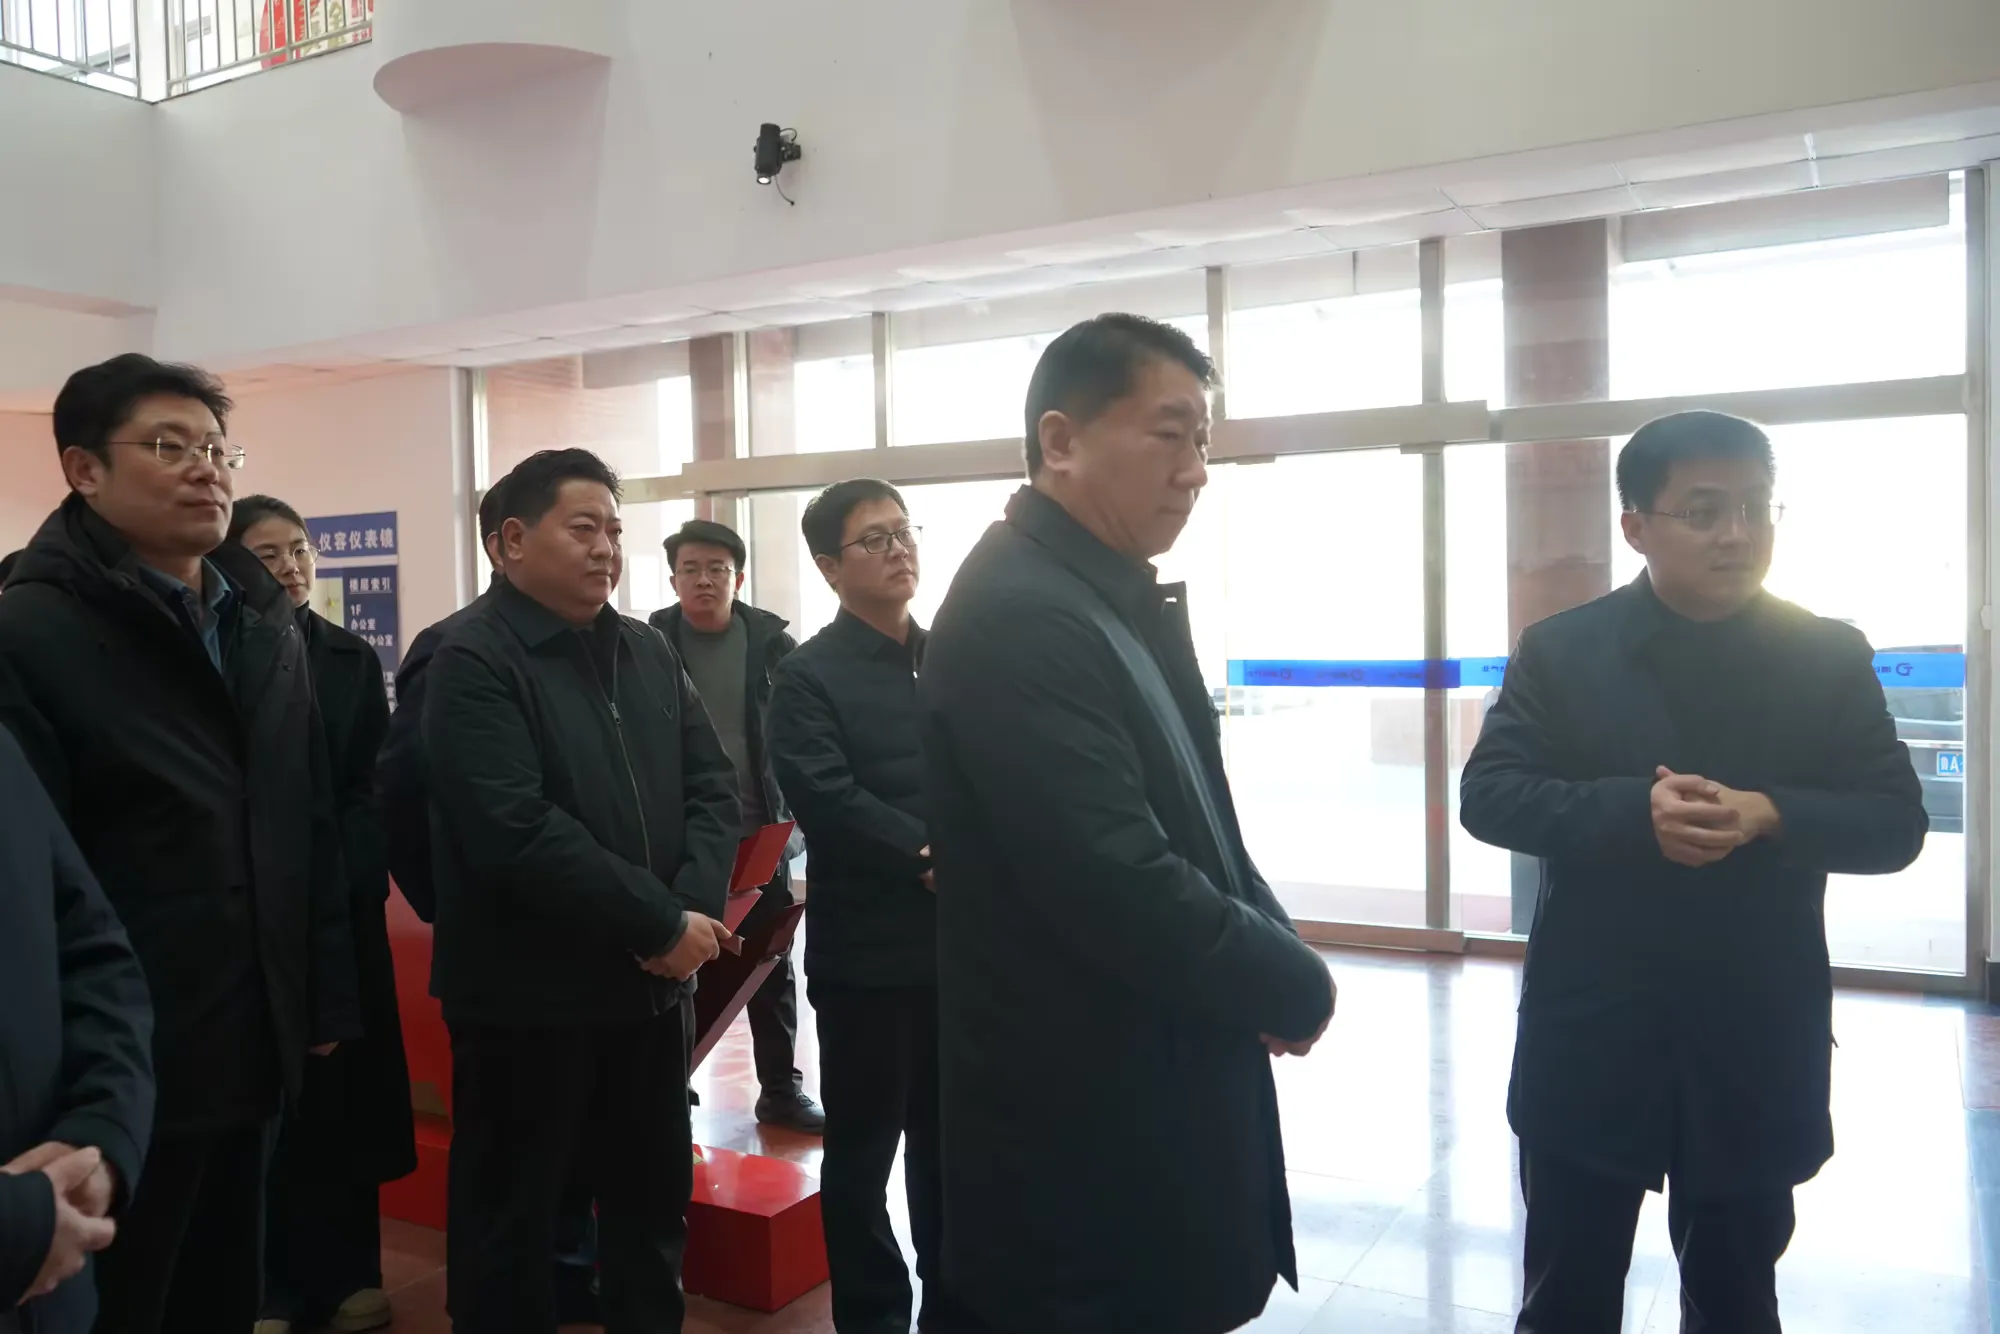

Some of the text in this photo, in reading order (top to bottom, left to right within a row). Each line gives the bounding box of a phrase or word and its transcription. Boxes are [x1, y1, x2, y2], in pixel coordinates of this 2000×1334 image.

[319, 528, 395, 552] 仪容仪表镜
[349, 577, 391, 593] 楼层索引
[350, 603, 362, 617] 1F
[350, 617, 377, 631] 办公室
